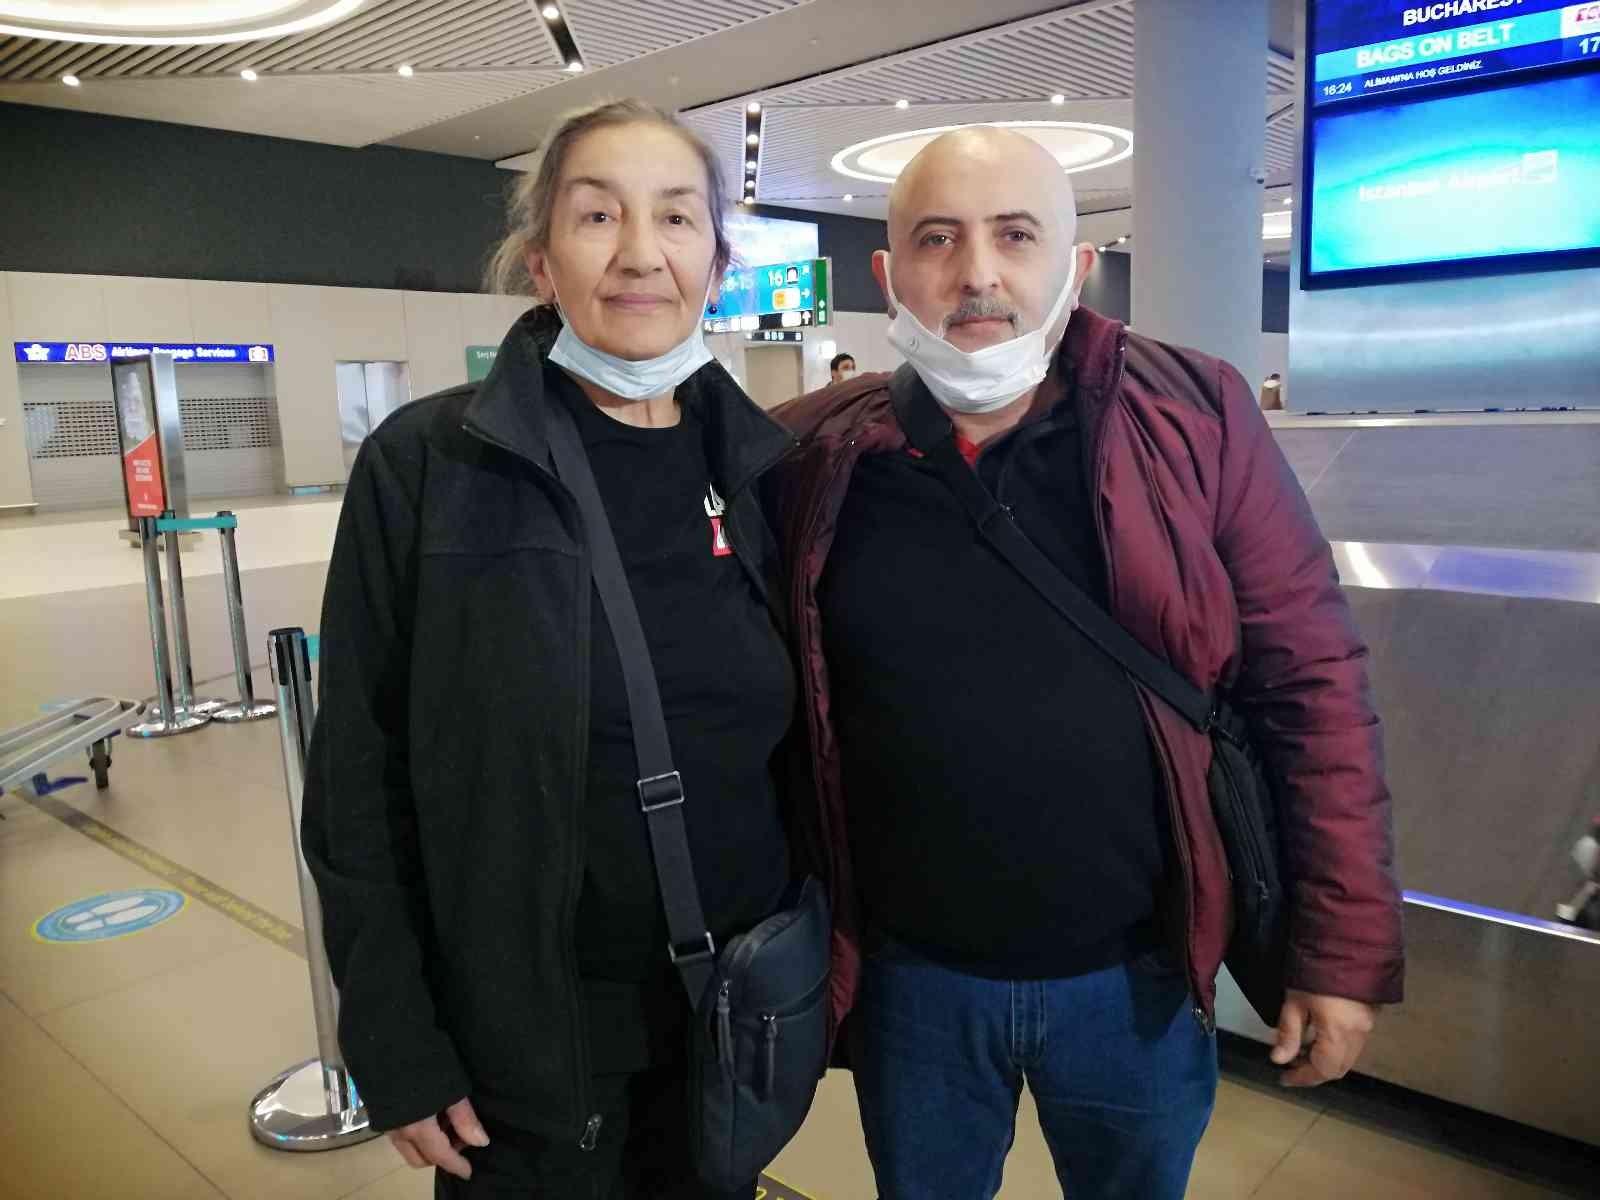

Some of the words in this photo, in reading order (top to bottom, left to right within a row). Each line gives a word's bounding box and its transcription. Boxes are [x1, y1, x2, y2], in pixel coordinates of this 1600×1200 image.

[1403, 0, 1521, 26] BUCHARE
[1356, 42, 1412, 69] BAGS
[1419, 33, 1453, 56] ON
[1457, 23, 1515, 50] BELT
[64, 344, 107, 361] ABS
